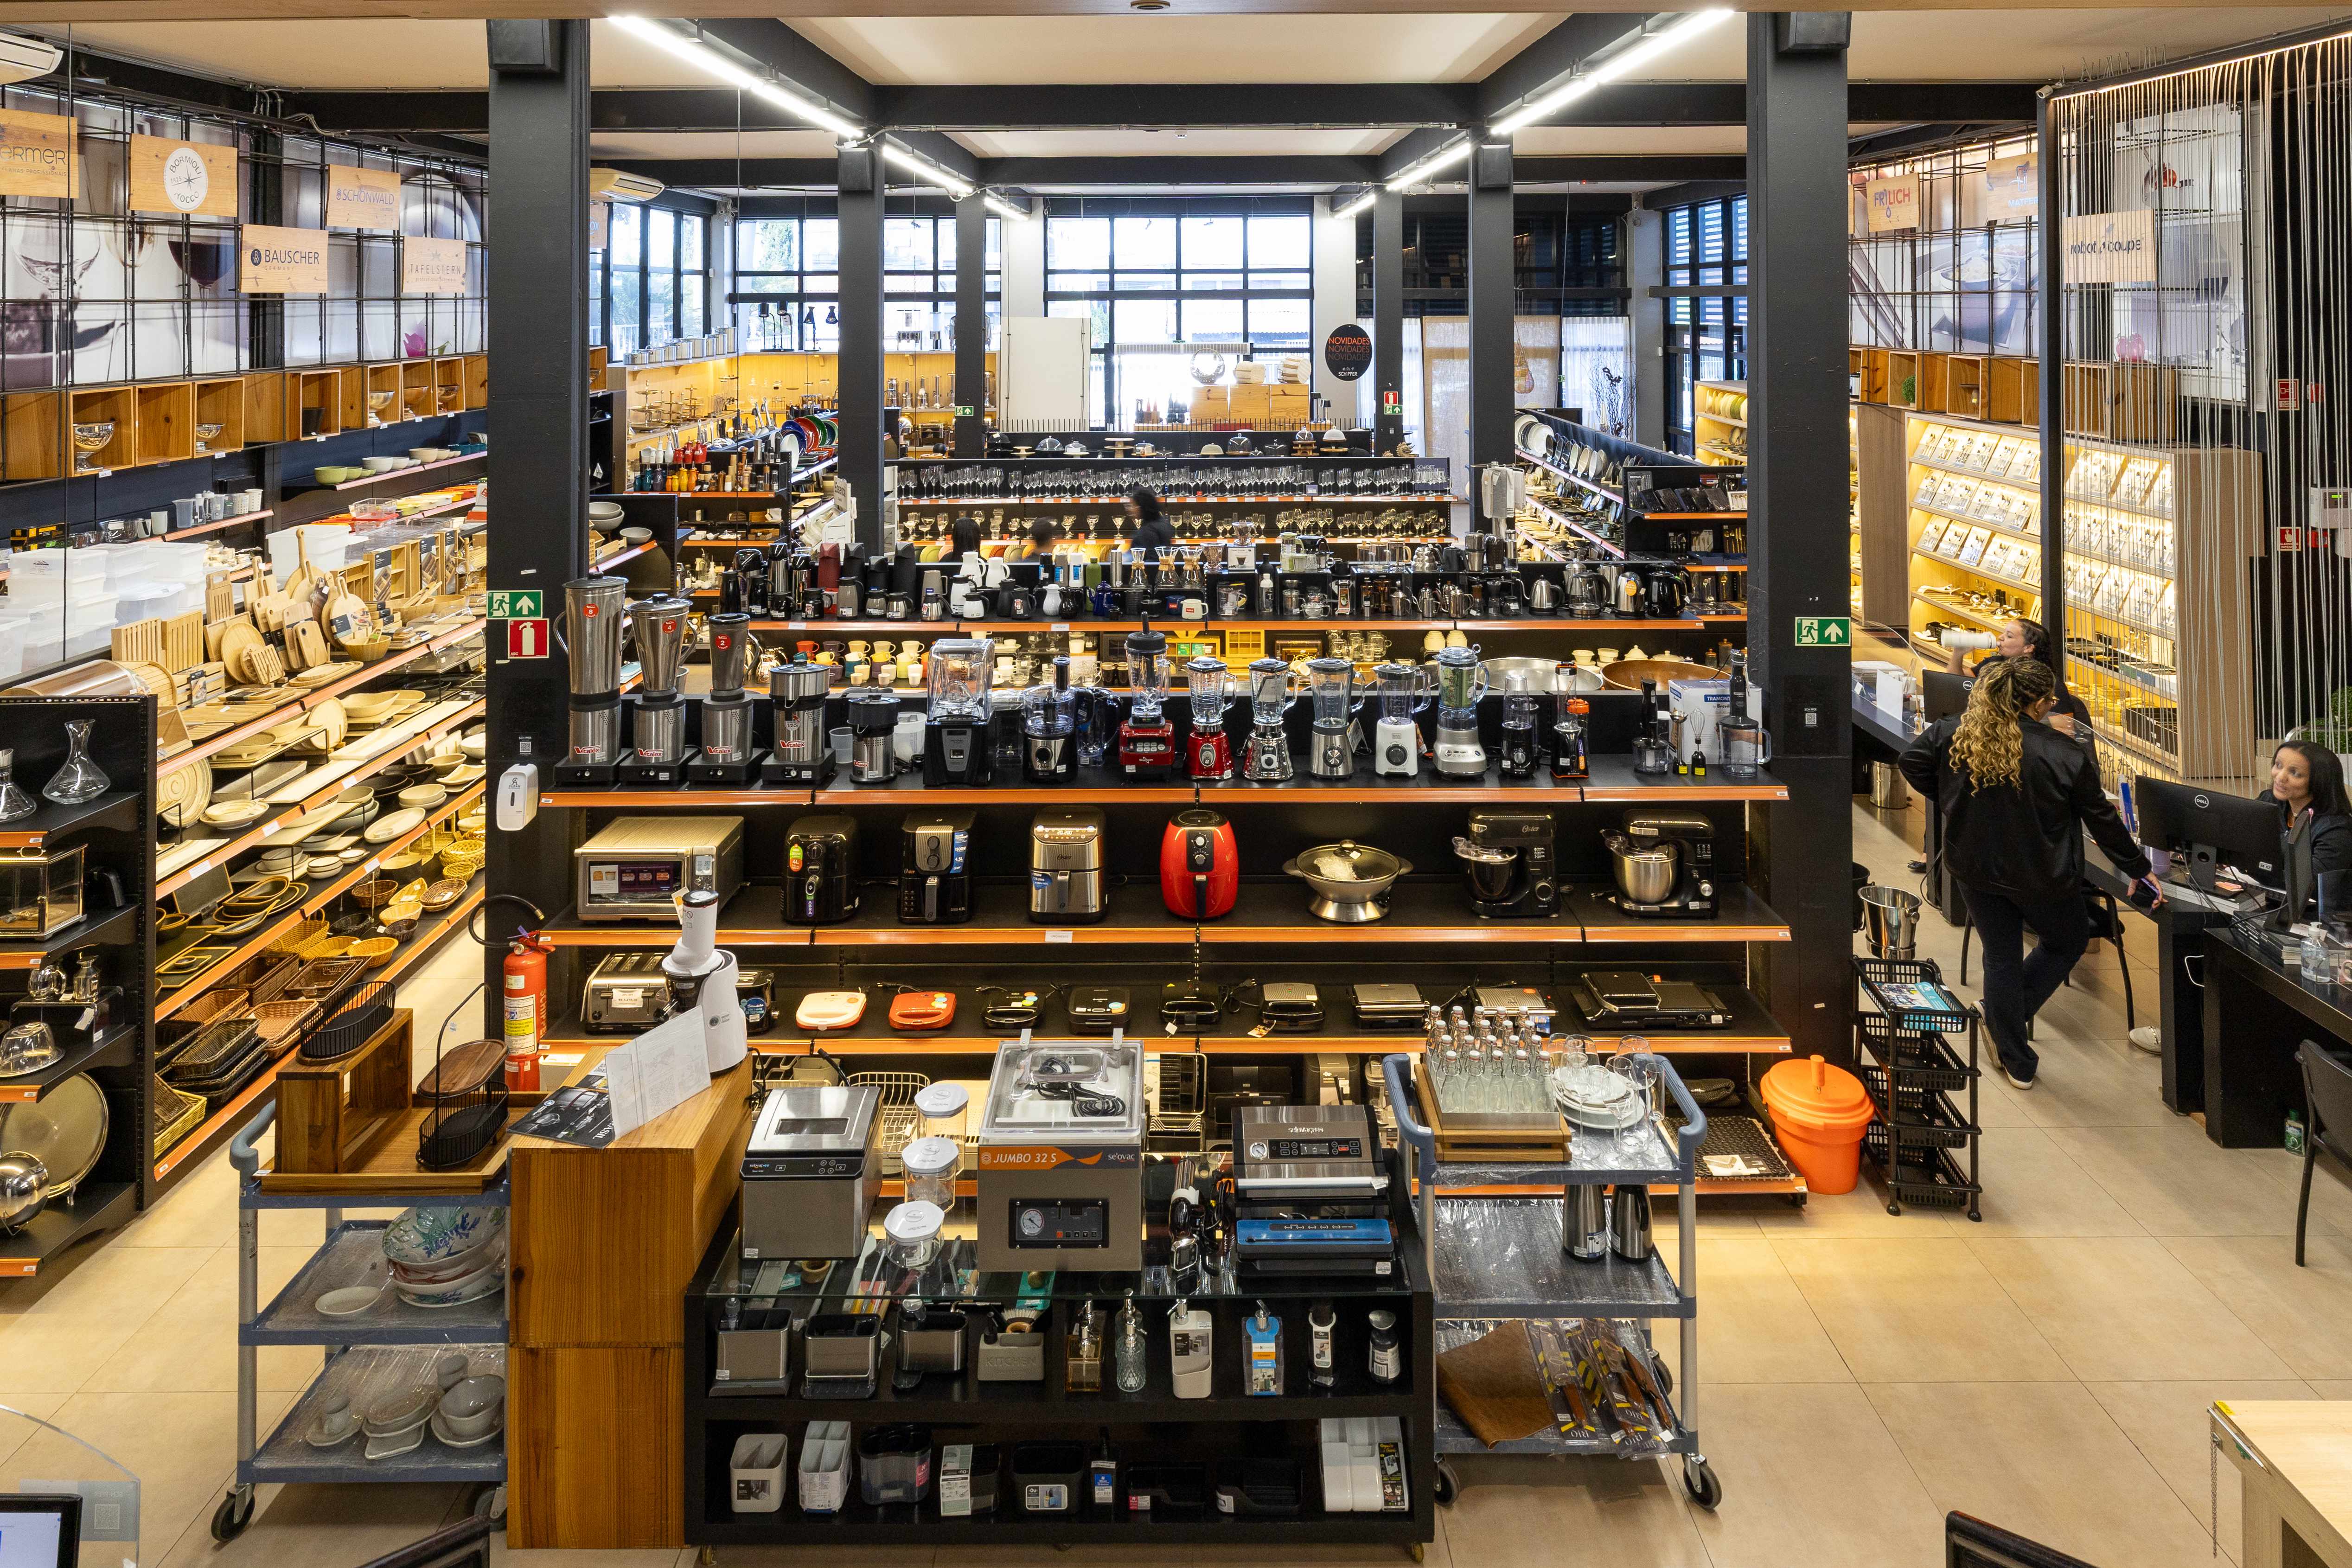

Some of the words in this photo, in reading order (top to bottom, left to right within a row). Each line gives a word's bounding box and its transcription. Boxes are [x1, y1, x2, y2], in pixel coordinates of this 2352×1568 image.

[169, 156, 202, 175] BORMIOLI
[342, 188, 395, 205] SCHÖNWALD
[265, 250, 320, 264] BAUSCHER
[410, 264, 460, 275] TAFELSTERN
[1328, 337, 1370, 345] NOVIDADES
[780, 740, 806, 748] Vitalex
[575, 745, 601, 754] Vitalex
[638, 748, 664, 757] Vitalex
[706, 746, 733, 754] Vitalex
[593, 1120, 614, 1139] ASIL
[993, 1153, 1031, 1163] JUMBO
[1034, 1153, 1047, 1163] 32
[1050, 1153, 1057, 1163] S
[987, 1357, 1037, 1366] KITCHEN
